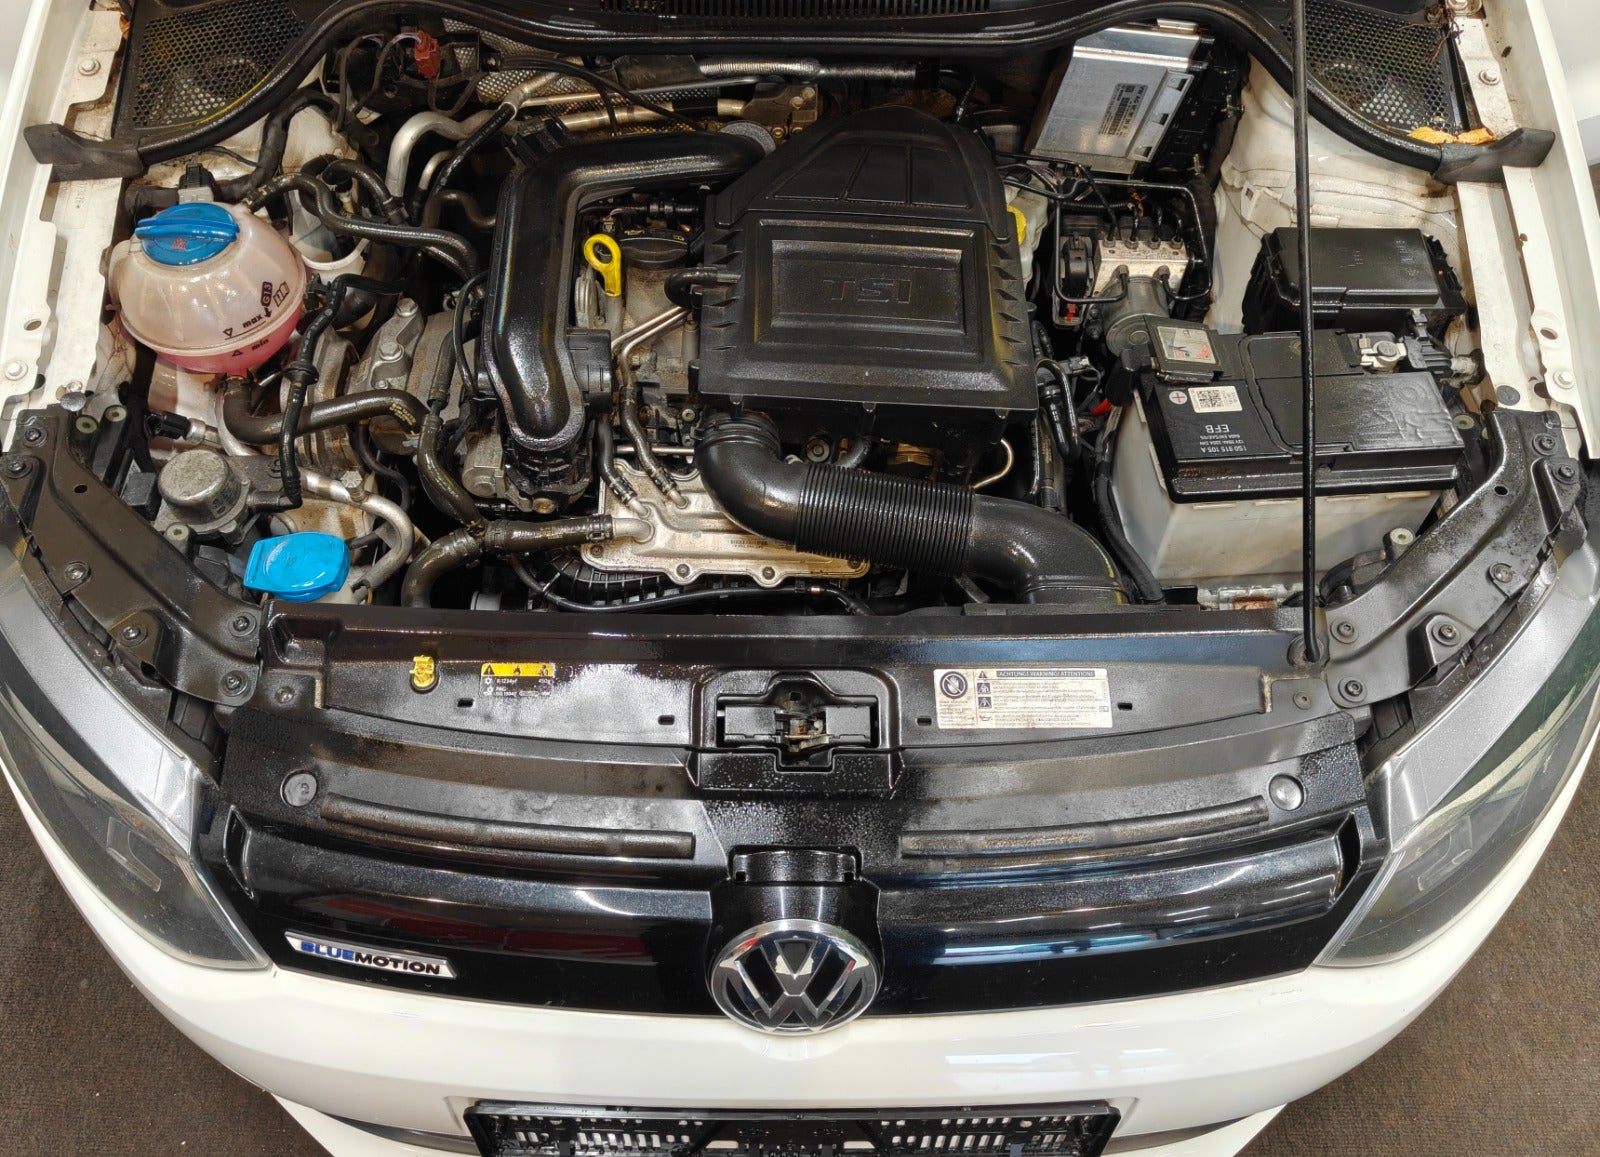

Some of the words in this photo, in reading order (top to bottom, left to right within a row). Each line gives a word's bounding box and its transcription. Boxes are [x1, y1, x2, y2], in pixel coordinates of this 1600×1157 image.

[262, 282, 272, 305] G13
[822, 278, 913, 304] TSI
[243, 314, 262, 328] max
[252, 339, 268, 350] min
[1205, 424, 1230, 433] EFB
[300, 941, 441, 975] BLUEMOTION
[711, 919, 878, 1036] VW
